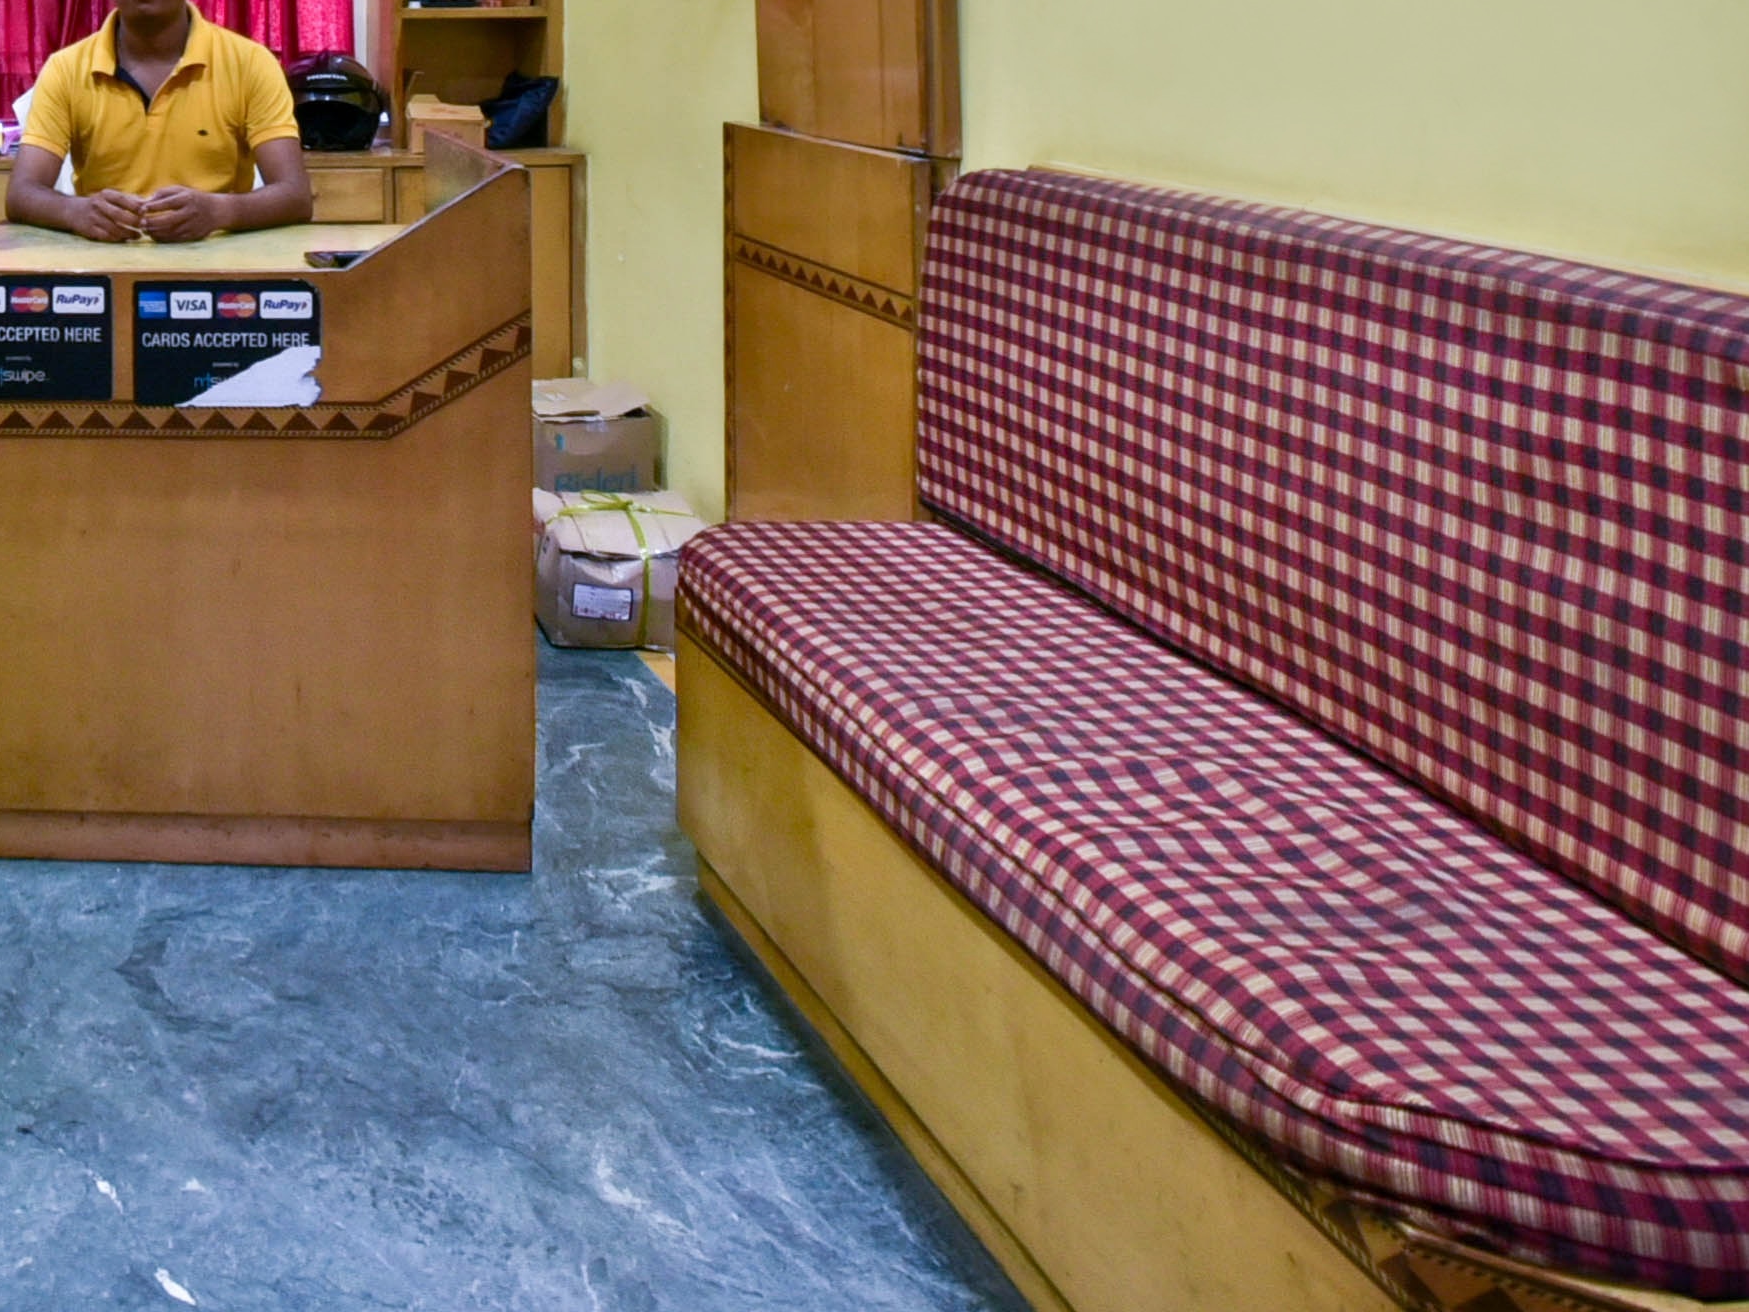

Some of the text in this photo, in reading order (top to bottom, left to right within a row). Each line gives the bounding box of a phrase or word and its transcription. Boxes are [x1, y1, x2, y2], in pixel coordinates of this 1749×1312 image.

[55, 293, 94, 307] RuPay
[175, 299, 208, 312] VISA
[263, 299, 302, 313] RuPay
[64, 327, 103, 343] HERE
[141, 331, 310, 348] CARDS ACCEPTED HERE
